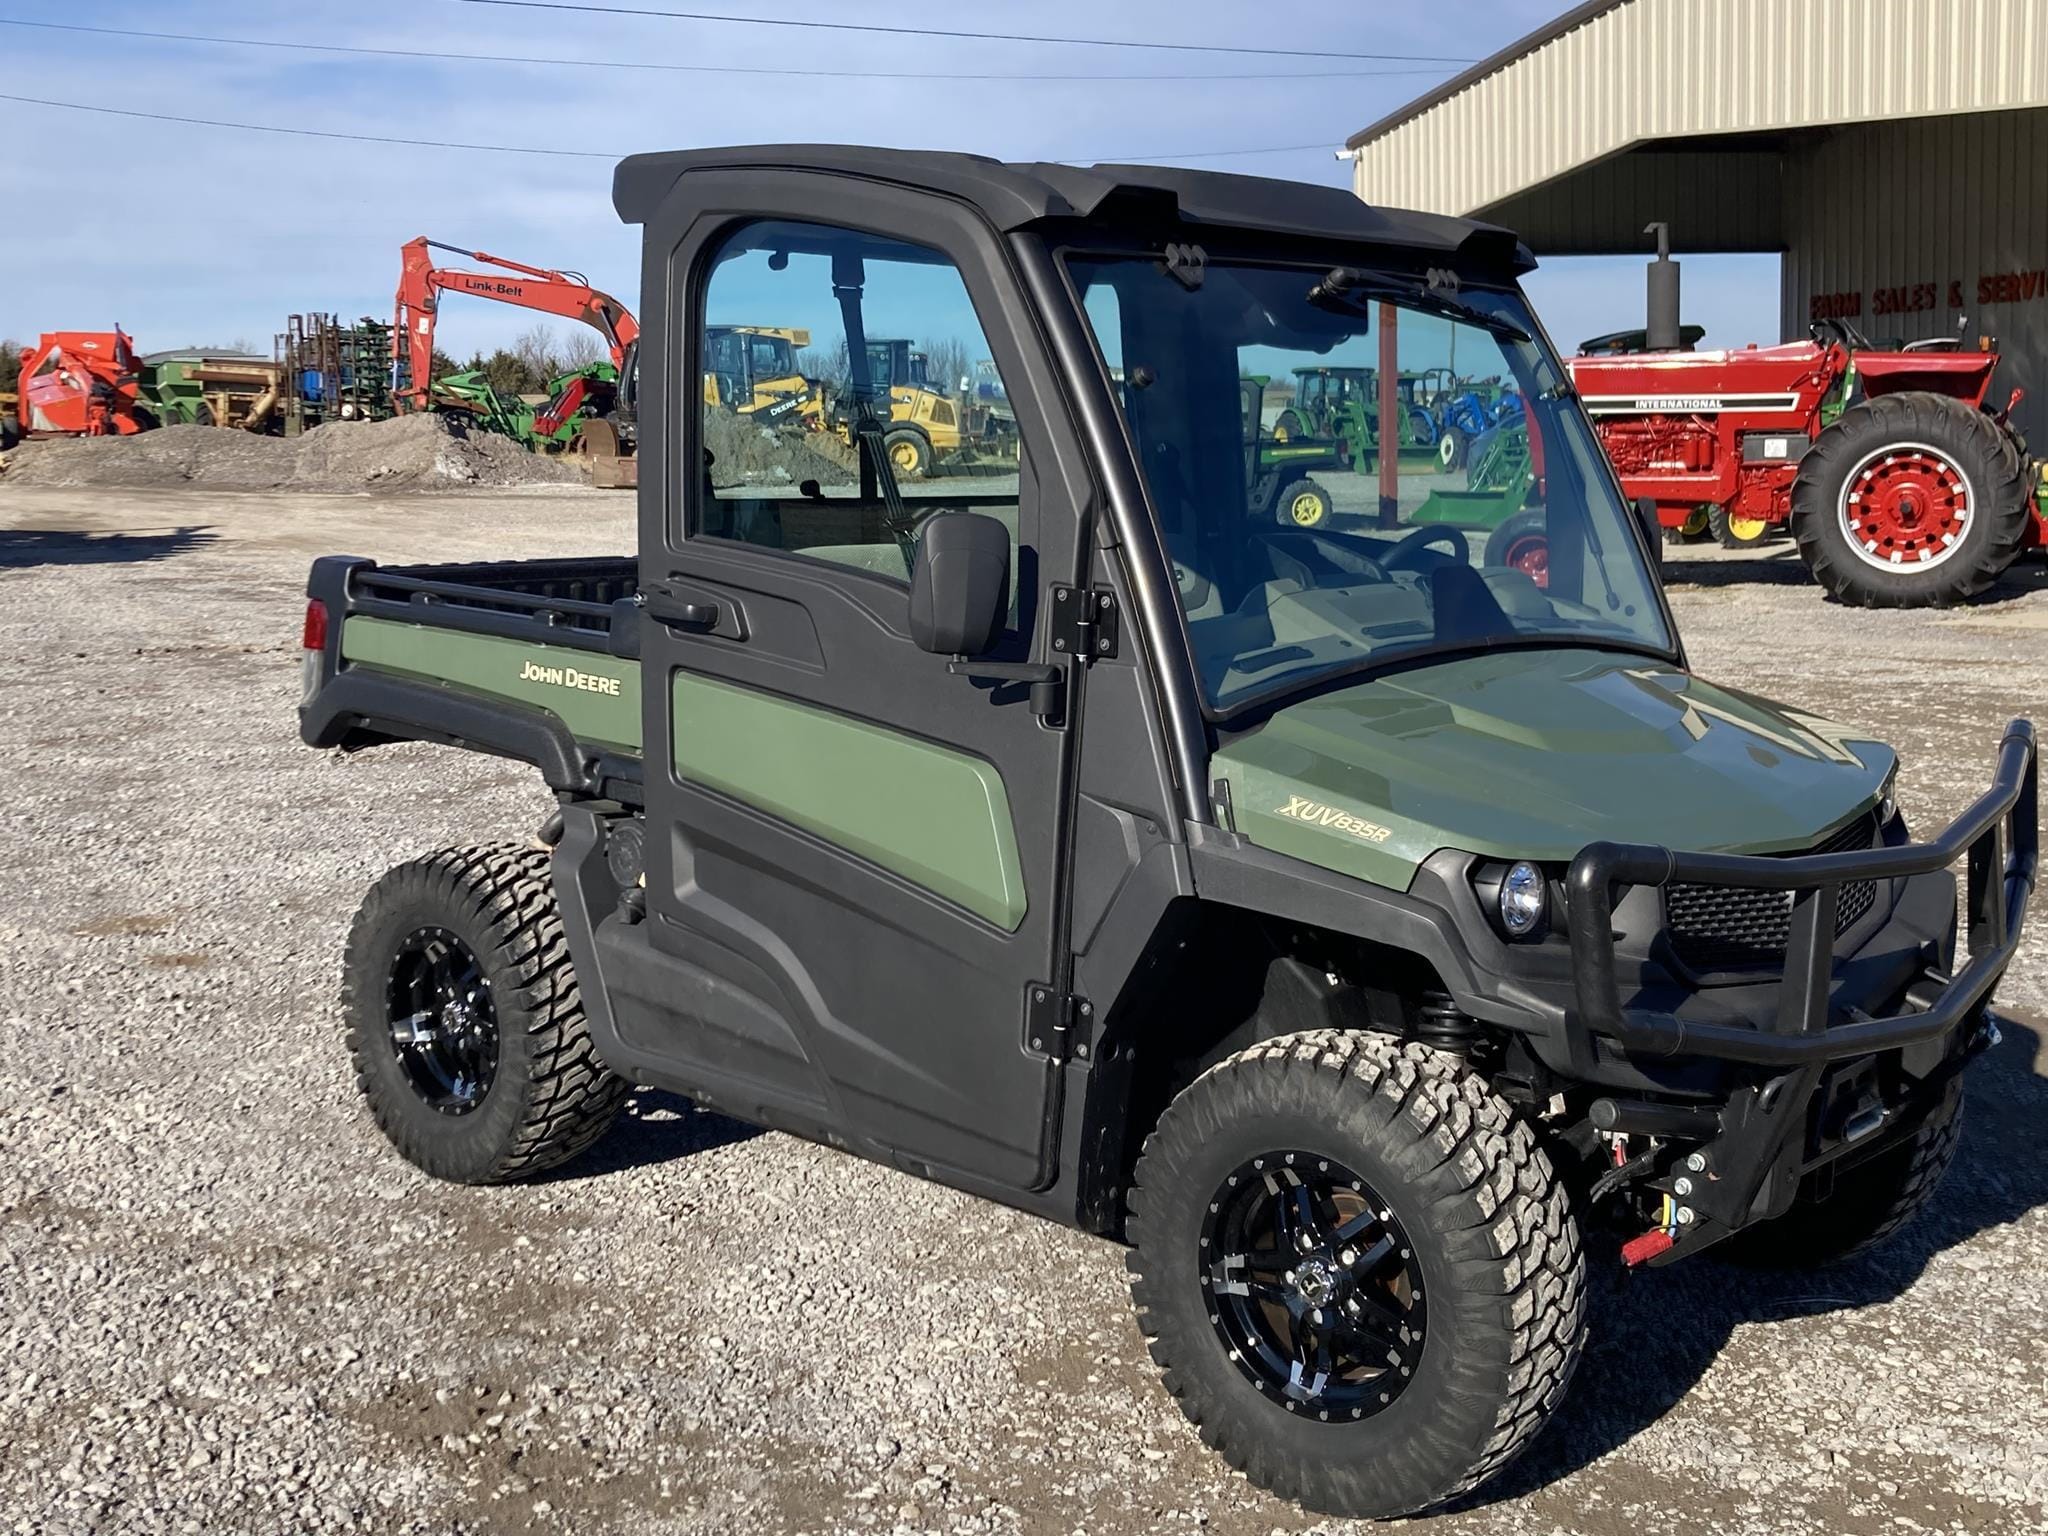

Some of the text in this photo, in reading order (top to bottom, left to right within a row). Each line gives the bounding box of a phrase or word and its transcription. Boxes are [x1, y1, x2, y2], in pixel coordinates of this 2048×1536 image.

[465, 278, 522, 297] Link-Belt
[1809, 270, 2048, 319] FARM SALES & SERVI
[770, 399, 798, 417] DEERE
[1635, 399, 1723, 409] INTERNATIONAL
[519, 660, 621, 696] JOHN DEERE
[1279, 797, 1392, 842] XUV835R
